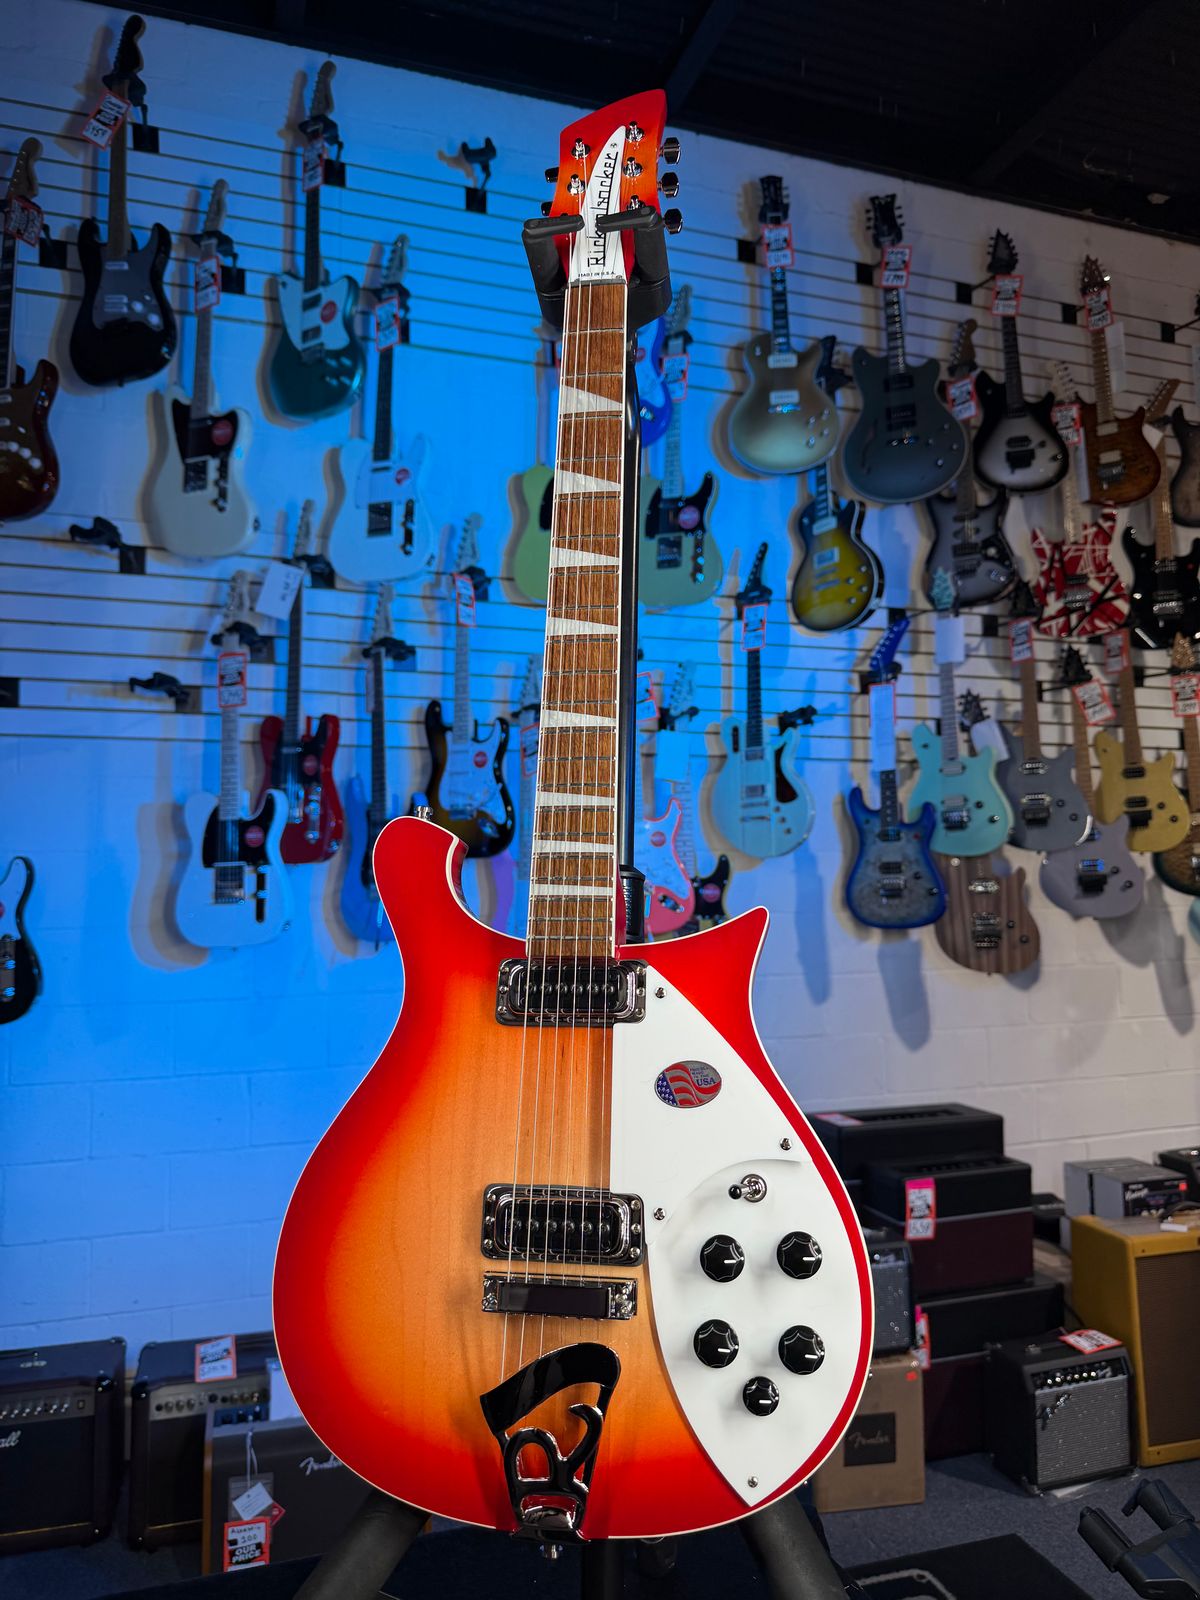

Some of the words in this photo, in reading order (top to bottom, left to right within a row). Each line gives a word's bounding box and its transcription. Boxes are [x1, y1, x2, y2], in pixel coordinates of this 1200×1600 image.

[696, 1077, 716, 1087] USA
[235, 1543, 257, 1556] OUR
[231, 1549, 262, 1564] PRICE
